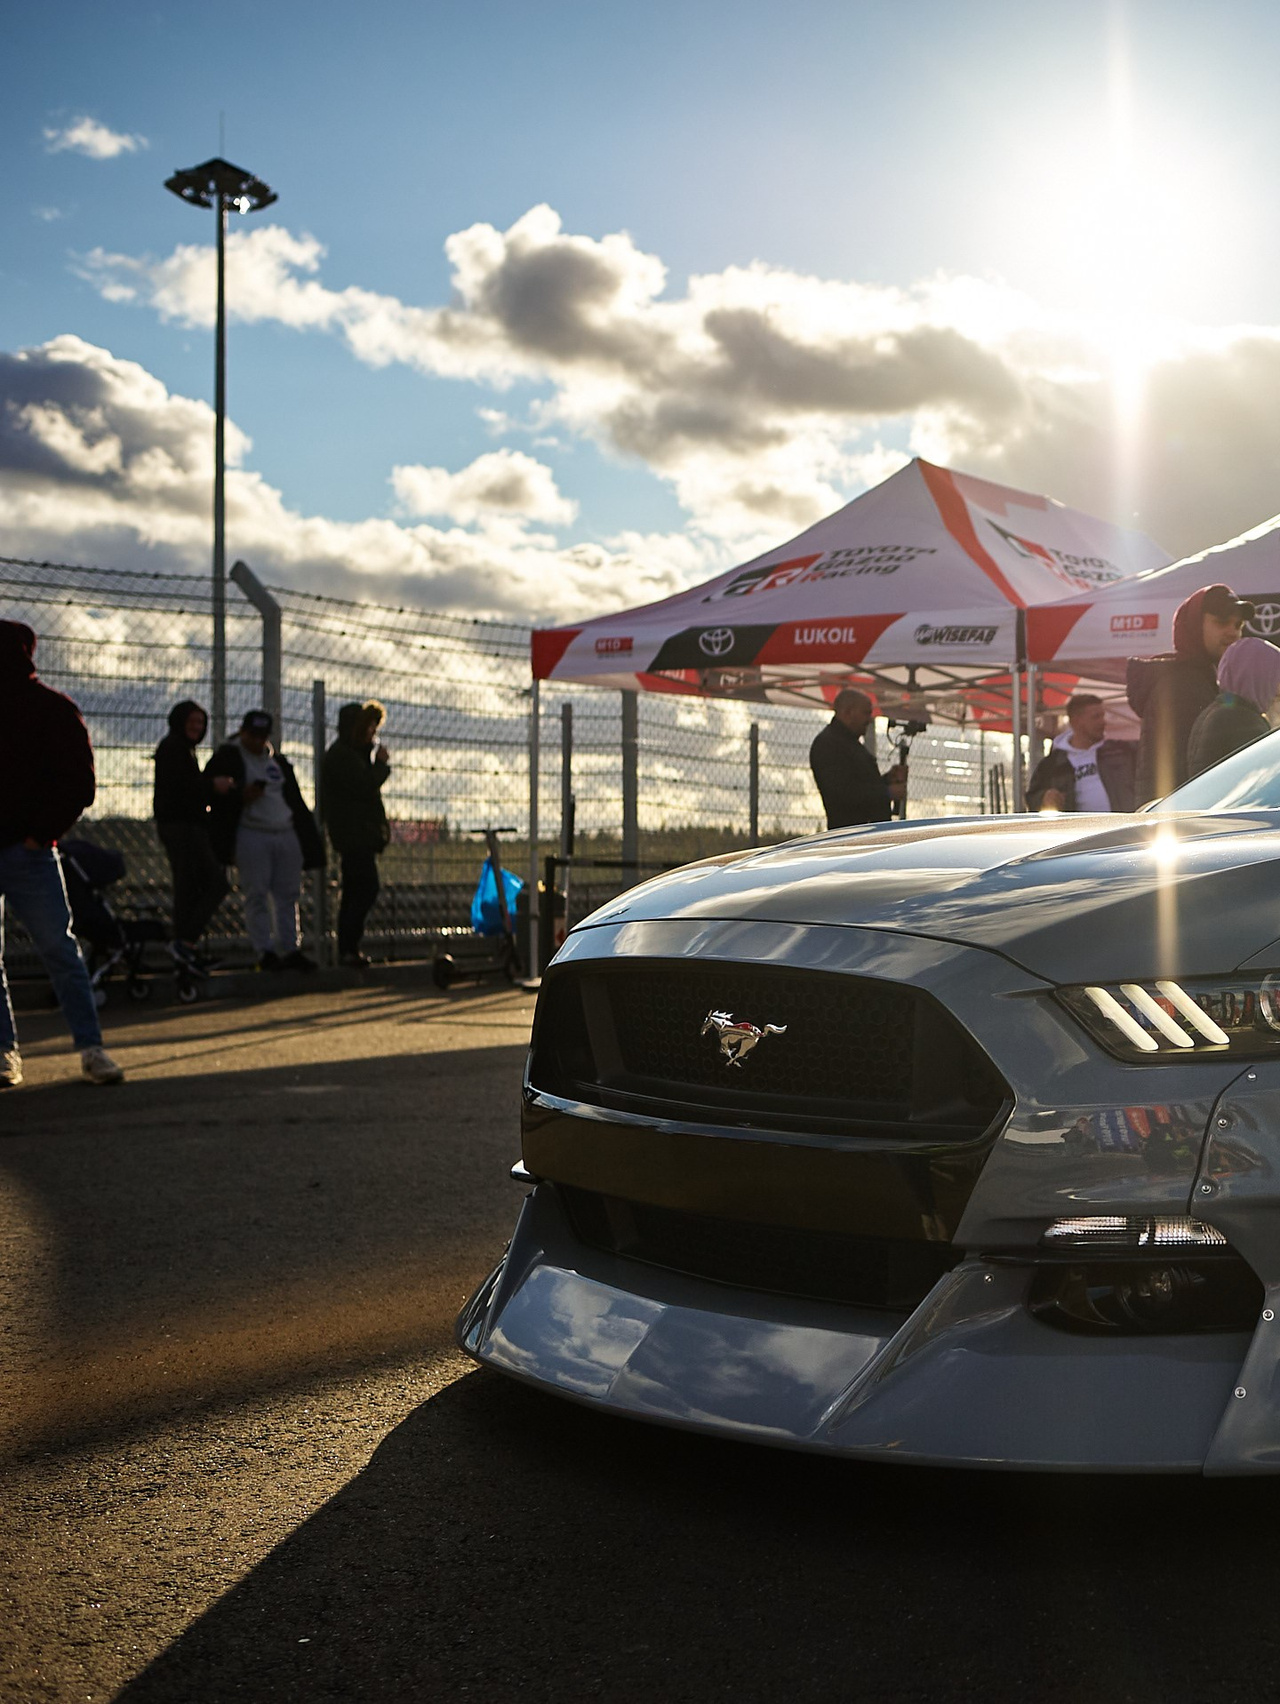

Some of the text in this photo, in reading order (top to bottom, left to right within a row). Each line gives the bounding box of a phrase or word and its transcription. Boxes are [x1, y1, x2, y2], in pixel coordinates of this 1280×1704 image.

[830, 545, 939, 560] TOYOTA
[812, 554, 917, 571] GAZOO
[800, 564, 901, 582] Racing
[1063, 564, 1123, 582] GAZO
[1112, 616, 1144, 629] M1D
[794, 627, 856, 645] LUKOIL
[933, 627, 997, 643] WISEFAB
